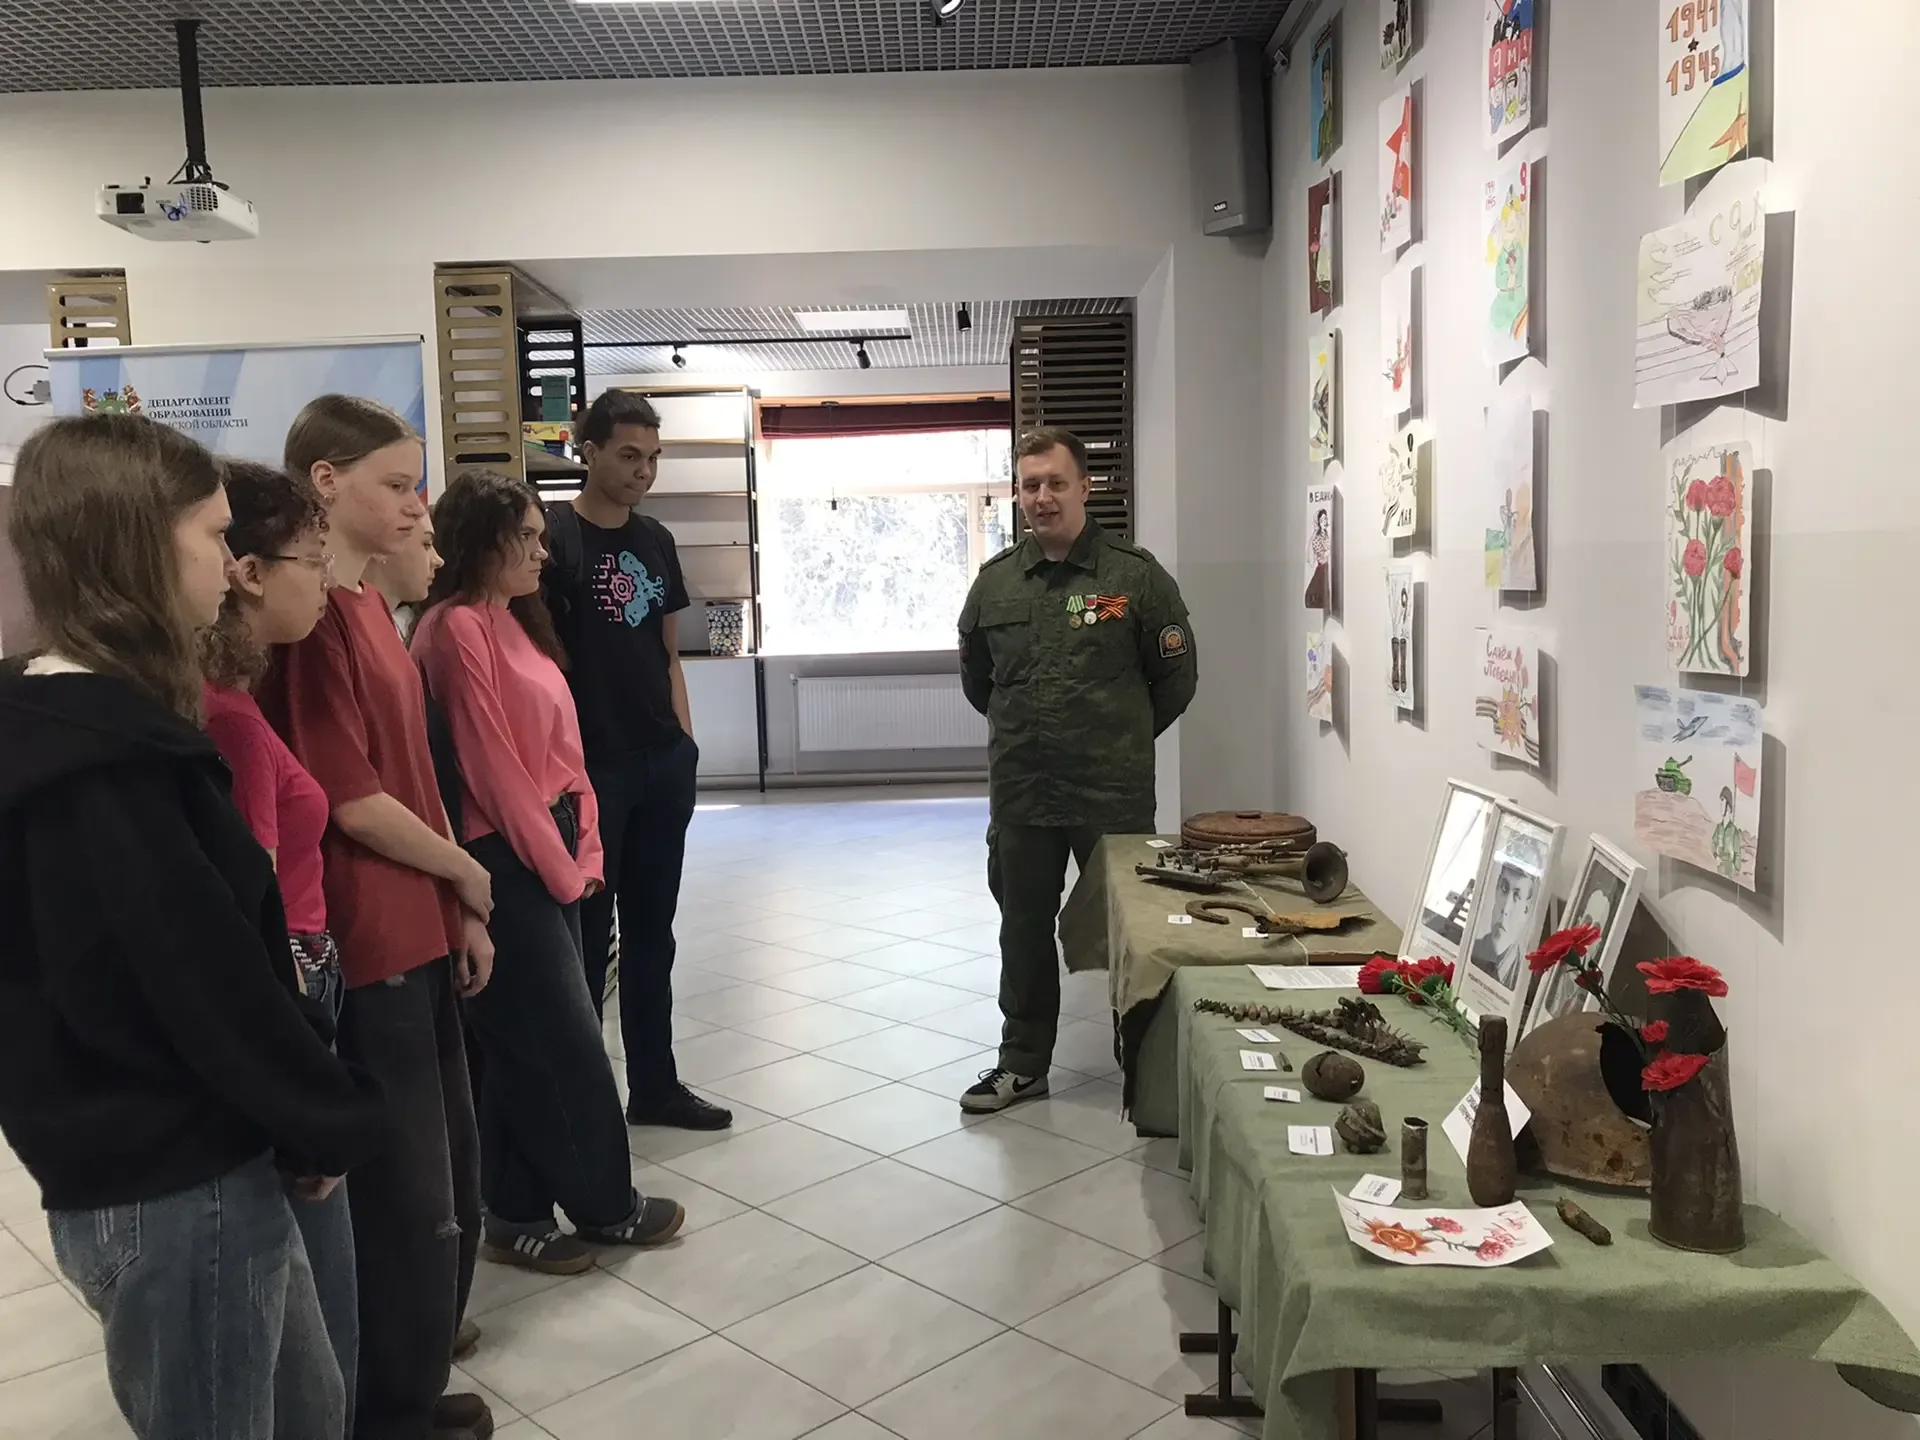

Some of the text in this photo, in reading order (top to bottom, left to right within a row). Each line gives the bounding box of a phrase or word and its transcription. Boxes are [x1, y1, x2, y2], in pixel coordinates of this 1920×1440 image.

[1665, 0, 1718, 42] 1941
[1666, 44, 1720, 96] 1945
[147, 396, 231, 409] ДЕПАРТАМЕНТ
[149, 408, 231, 419] ОБРАЗОВАНИЯ
[168, 418, 248, 430] СКОЙ ОБЛАСТИ
